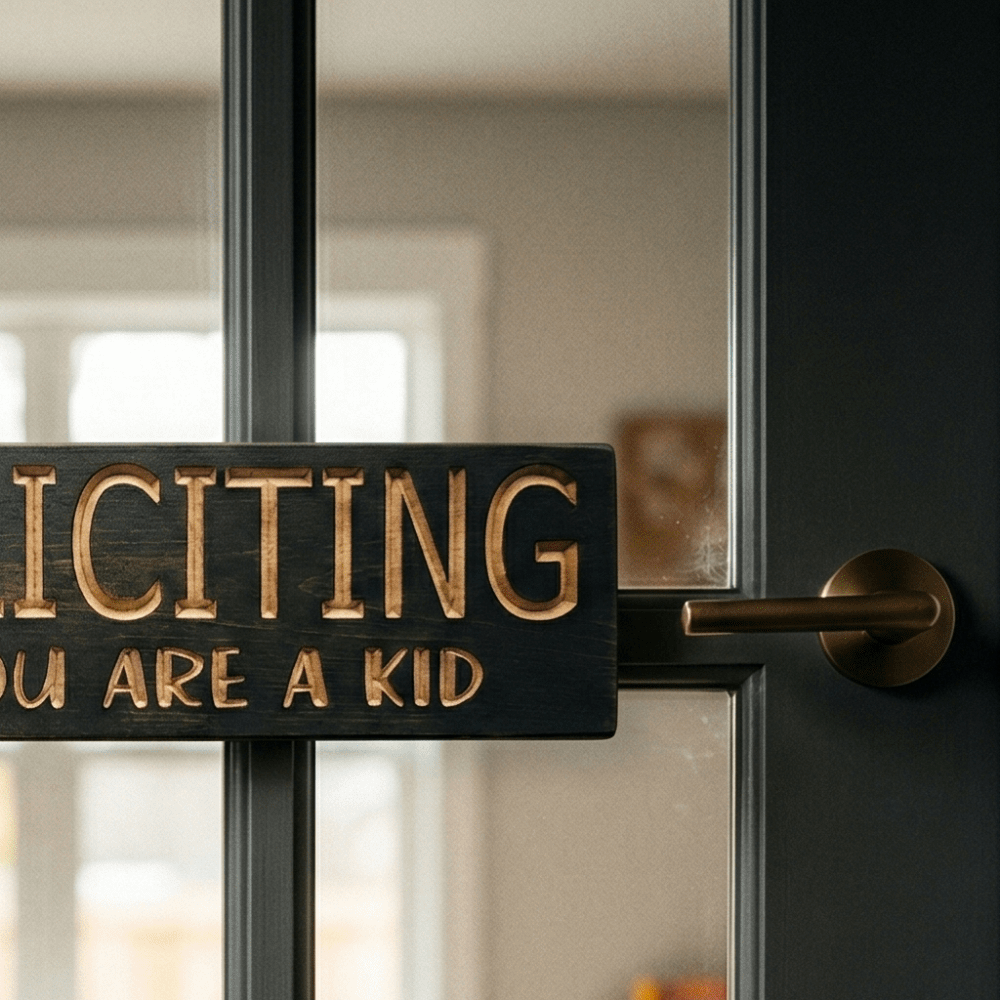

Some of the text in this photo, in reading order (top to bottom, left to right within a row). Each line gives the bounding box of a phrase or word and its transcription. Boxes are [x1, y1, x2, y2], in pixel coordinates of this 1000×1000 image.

[103, 648, 248, 710] ARE
[282, 648, 329, 710] A
[363, 648, 485, 709] KID
